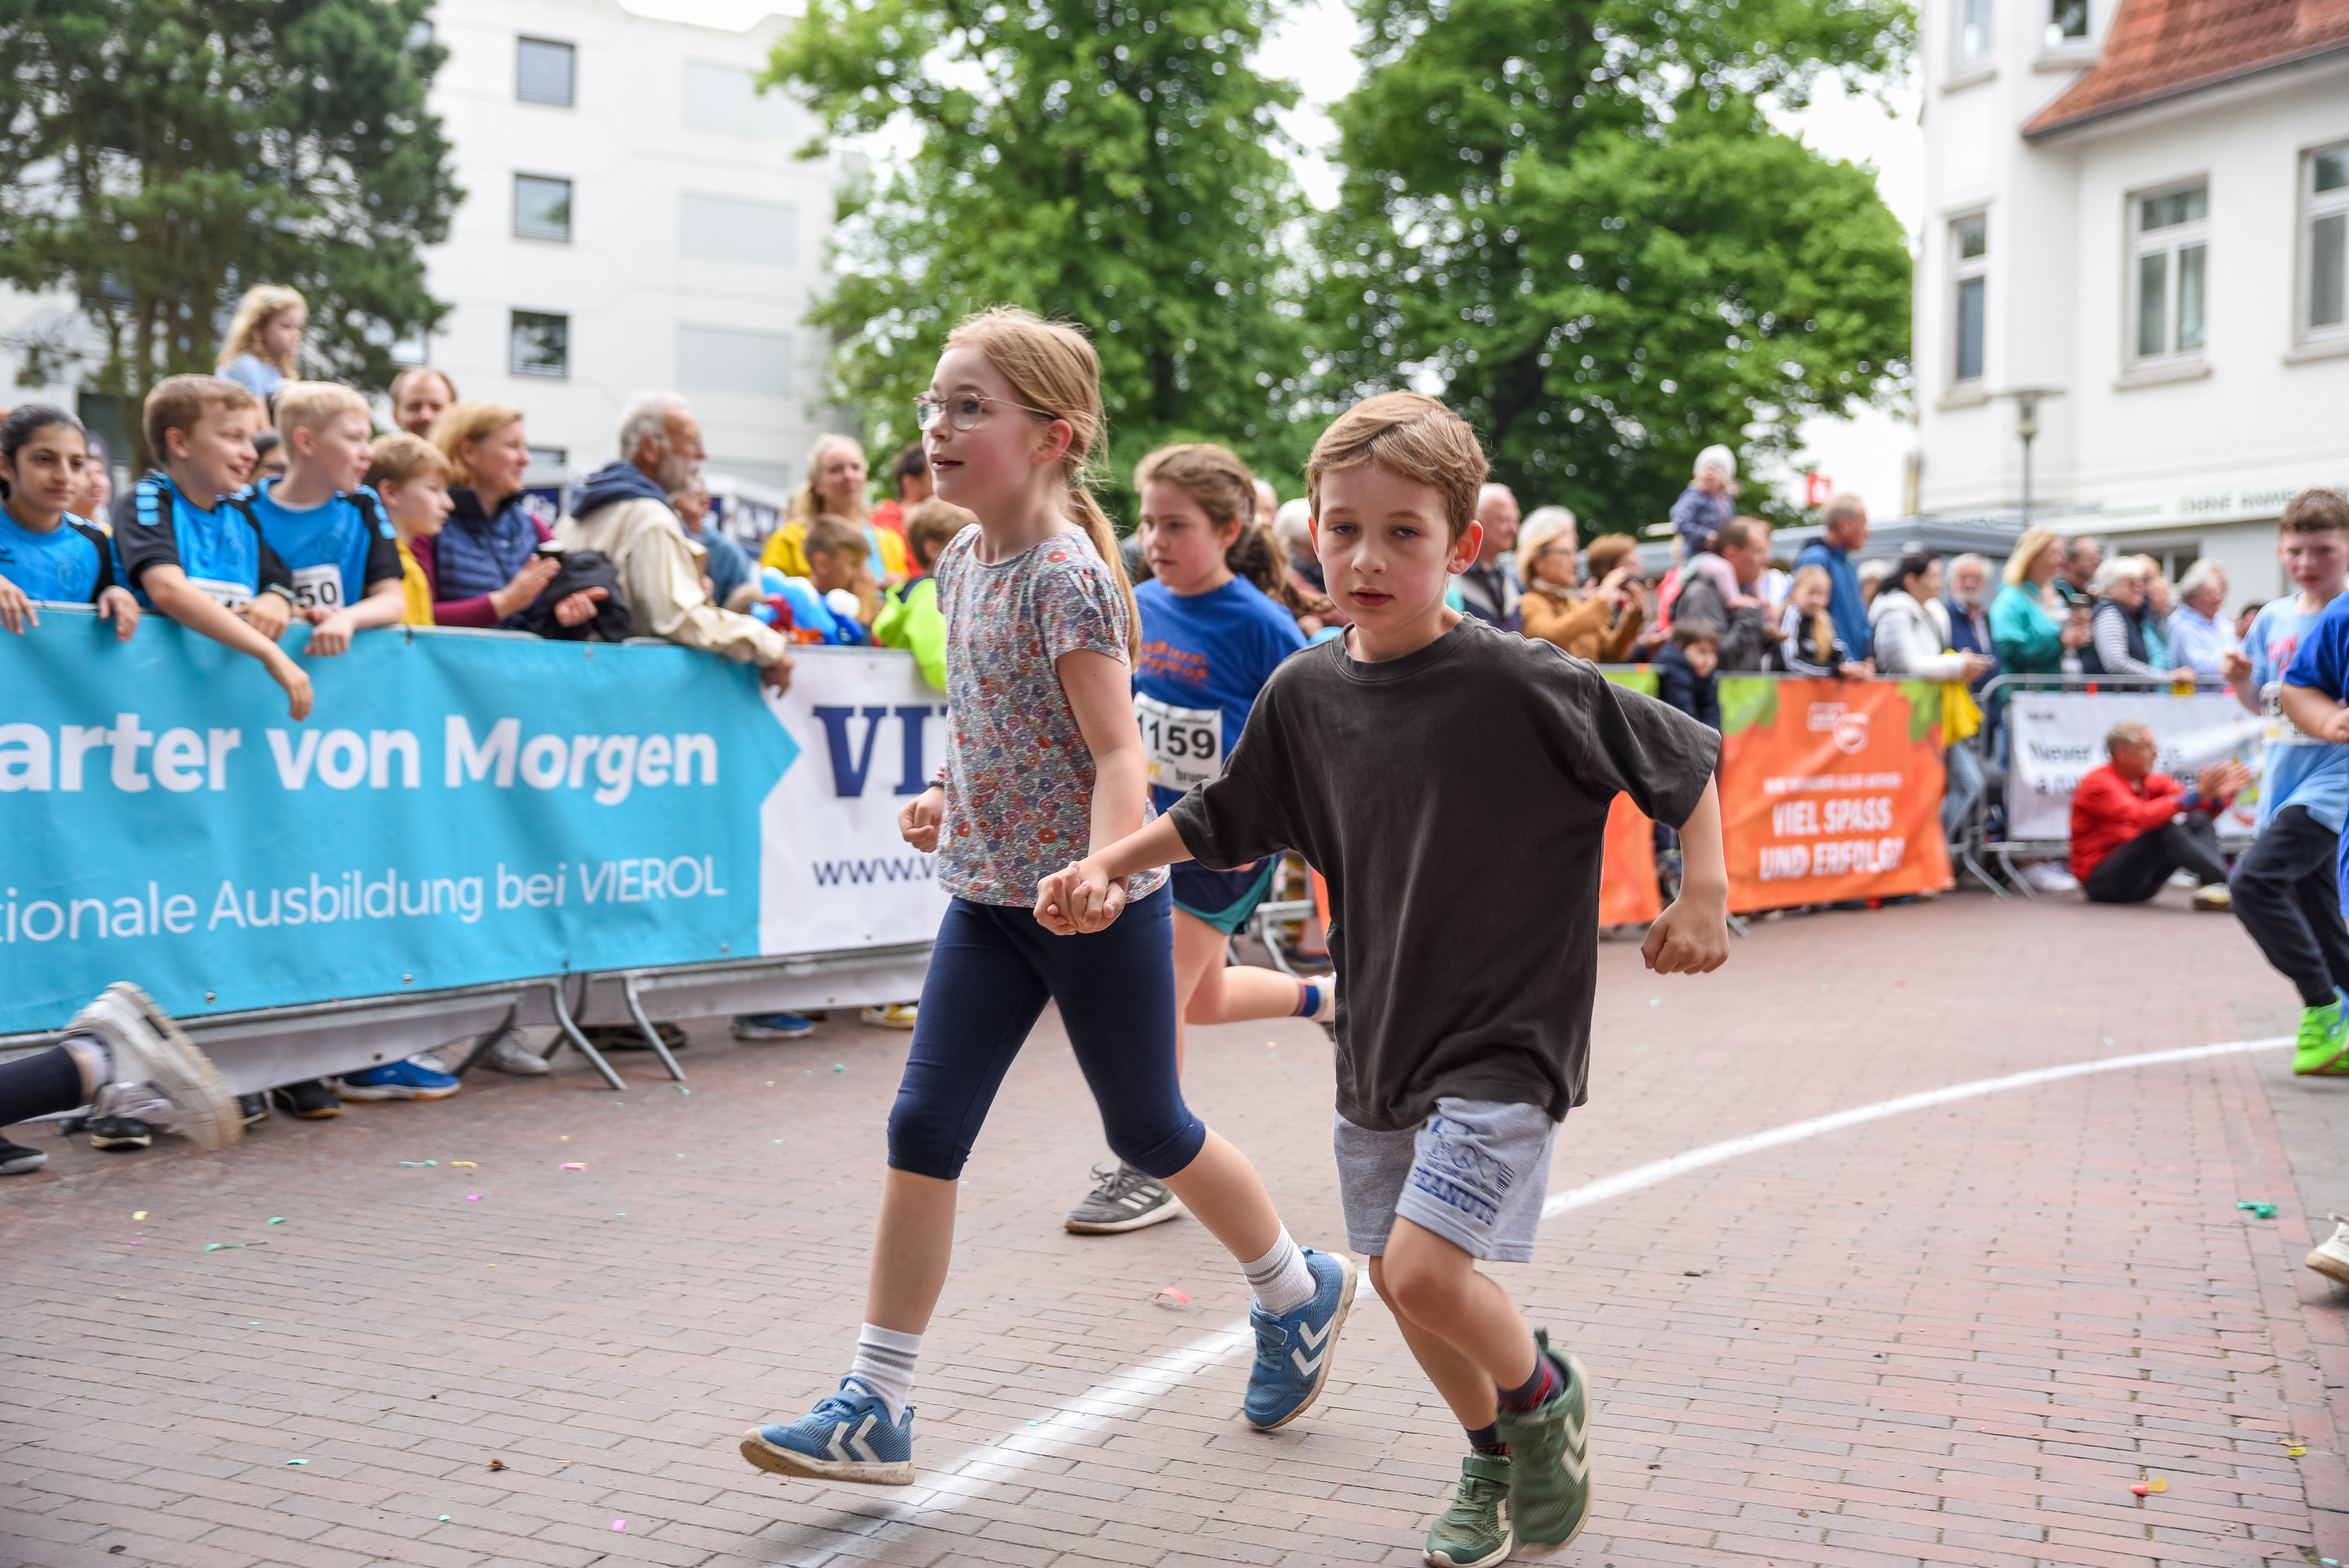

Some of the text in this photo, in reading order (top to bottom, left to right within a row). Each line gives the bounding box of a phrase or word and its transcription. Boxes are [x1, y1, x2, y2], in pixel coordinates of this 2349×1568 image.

[265, 728, 421, 790] von
[445, 715, 718, 806] Morgen
[812, 707, 947, 797] VI
[1773, 795, 1893, 837] VIEL SPASS
[0, 855, 727, 944] ionale Ausbildung bei VIEROL
[1759, 844, 1810, 882] UND
